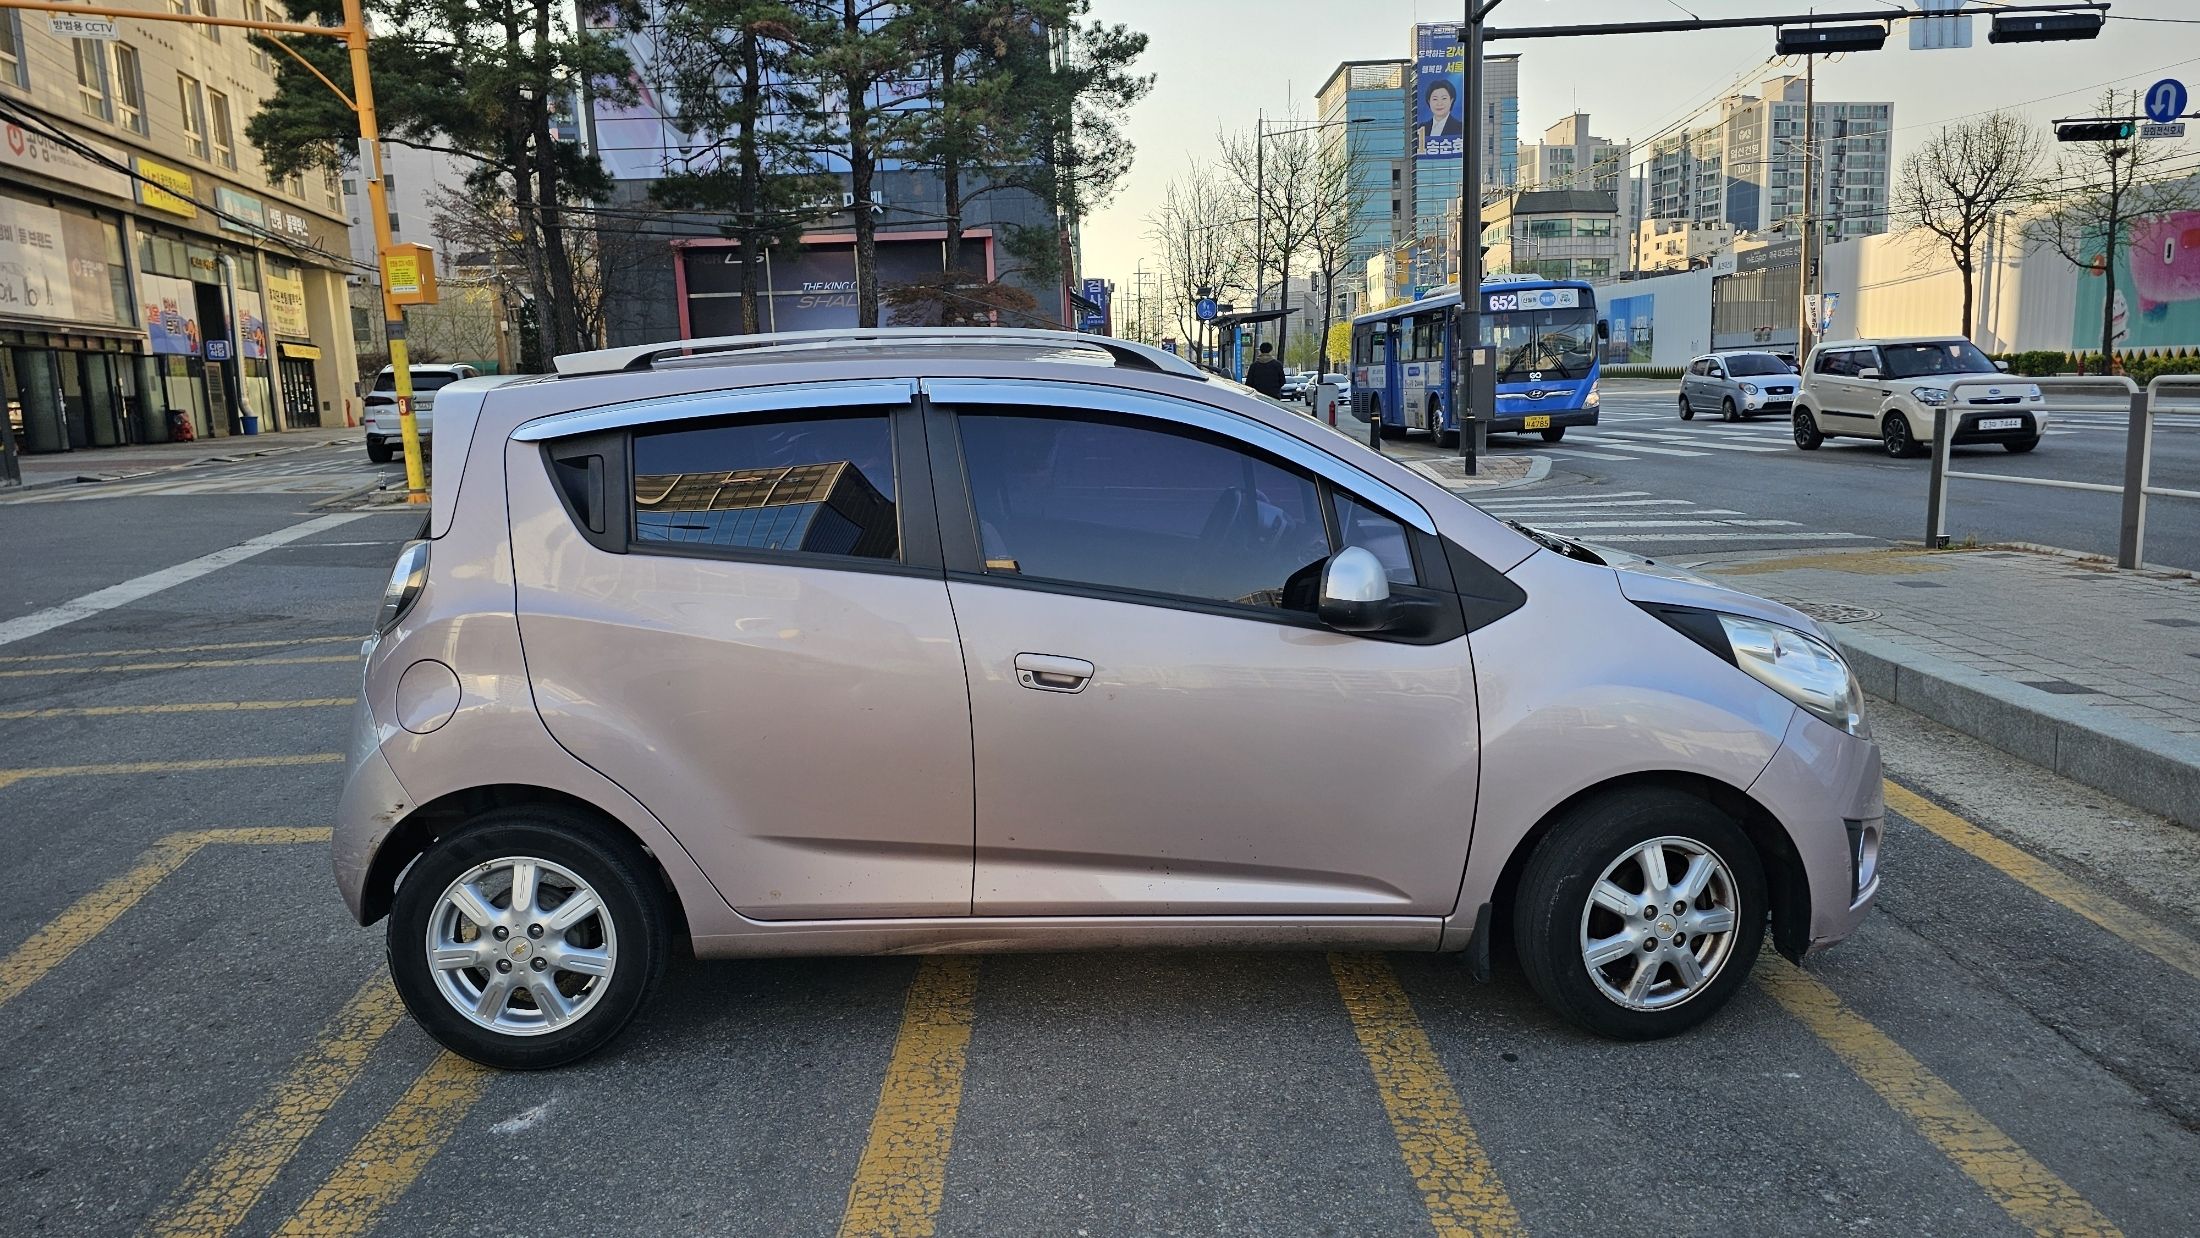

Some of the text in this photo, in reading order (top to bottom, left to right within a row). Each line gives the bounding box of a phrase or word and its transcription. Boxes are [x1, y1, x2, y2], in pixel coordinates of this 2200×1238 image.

[53, 19, 113, 32] 방범용 CCTV
[1418, 49, 1446, 58] 도약하는
[2142, 125, 2184, 137] 좌회전신호시
[1416, 125, 1427, 155] 1
[1736, 163, 1751, 174] 103
[1489, 294, 1518, 311] 652
